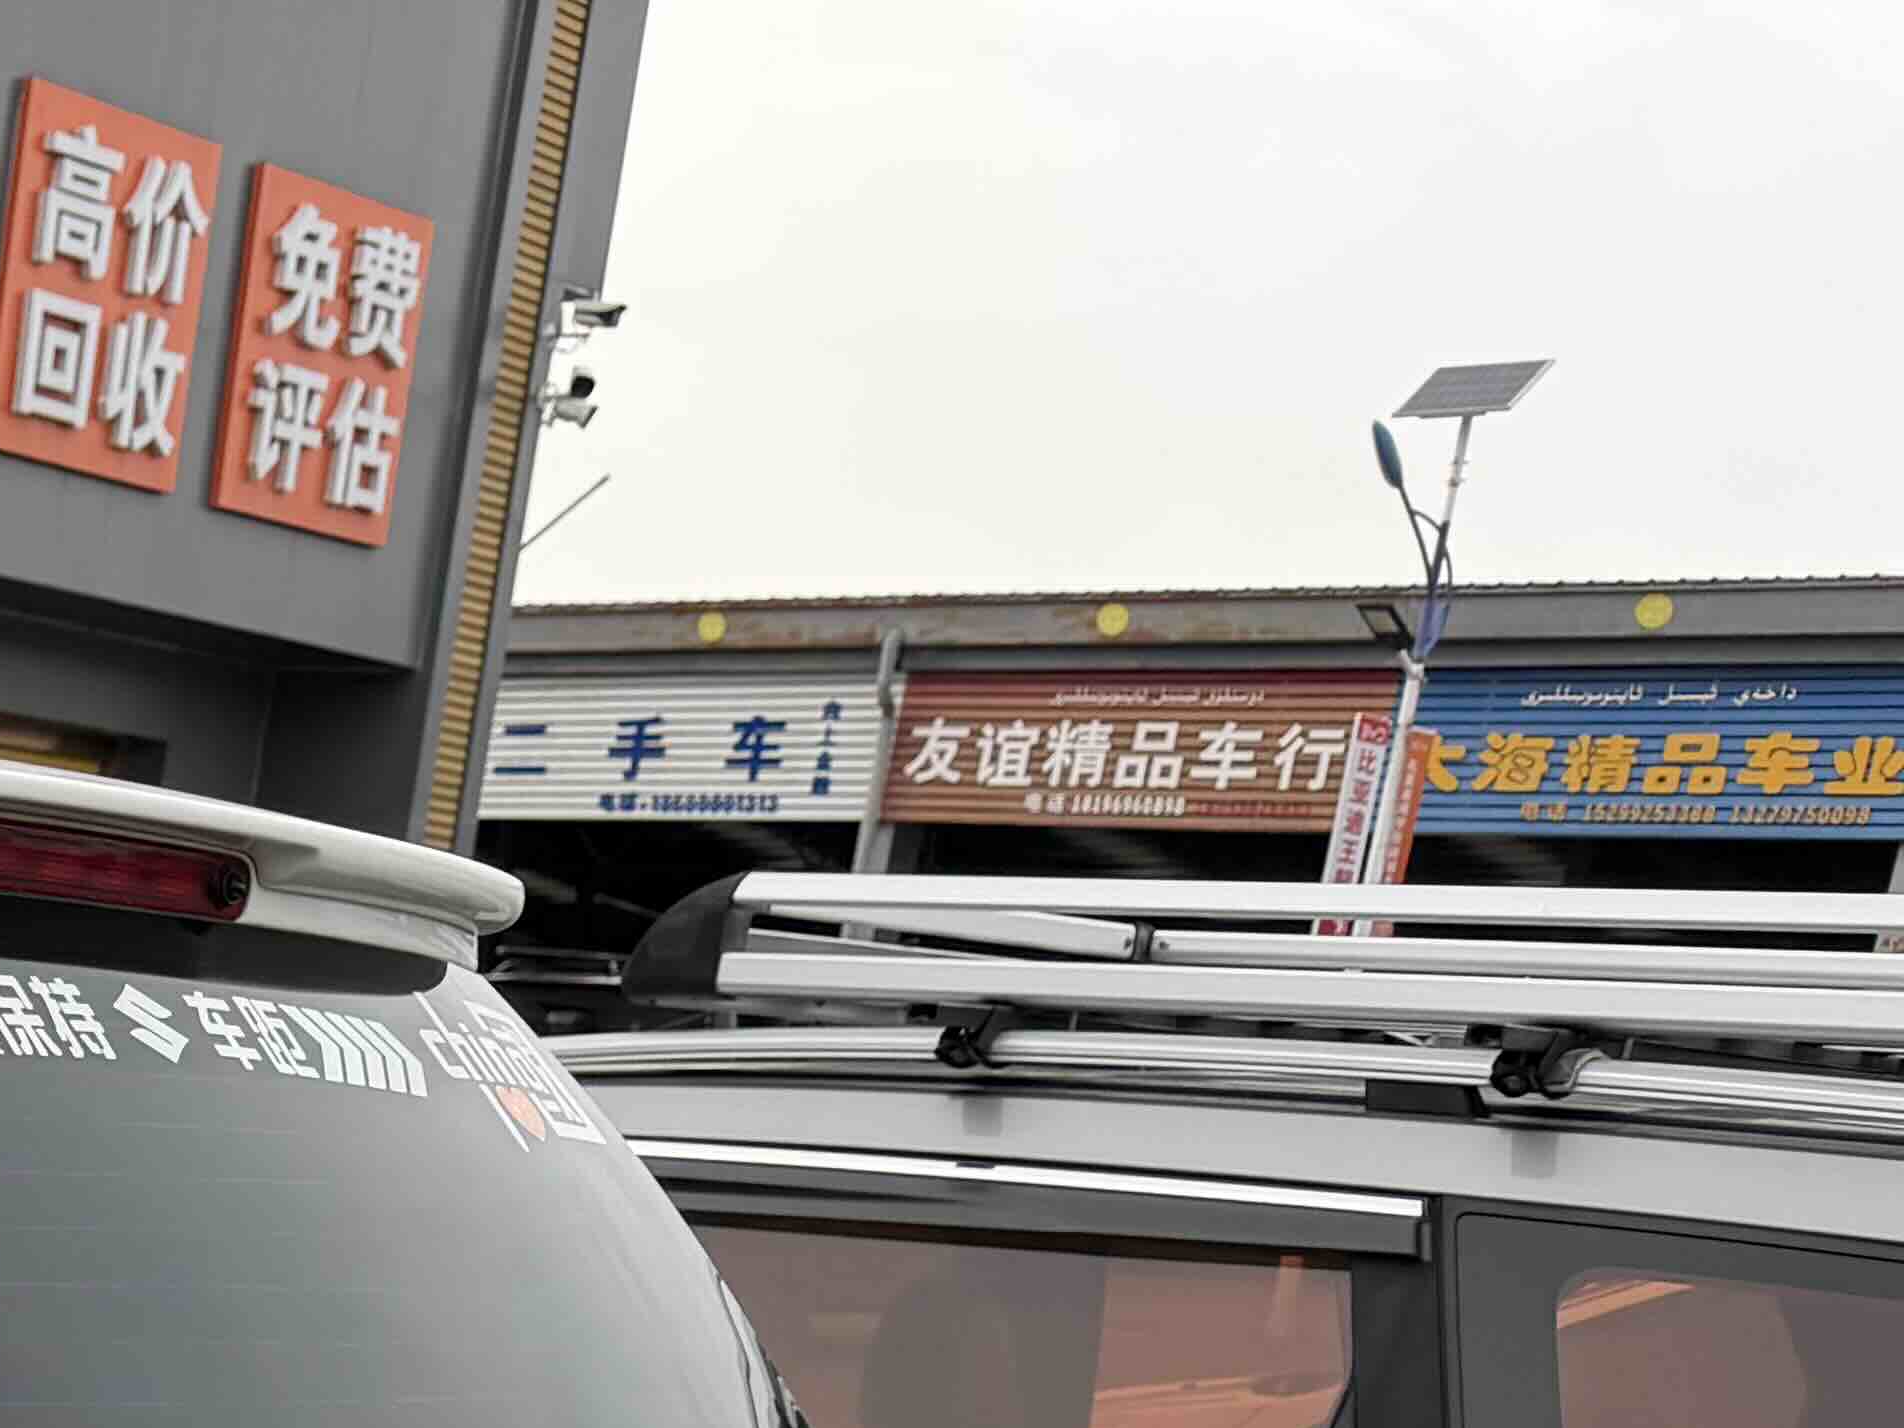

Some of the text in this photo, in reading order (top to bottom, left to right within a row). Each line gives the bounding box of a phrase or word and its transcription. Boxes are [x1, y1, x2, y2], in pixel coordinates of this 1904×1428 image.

[33, 125, 209, 306] 高价
[264, 202, 422, 370] 免费
[12, 286, 186, 460] 回收
[246, 359, 401, 516] 评估
[492, 716, 787, 782] 二手车
[904, 718, 1346, 792] 友谊精品车行
[182, 990, 319, 1078] 车距
